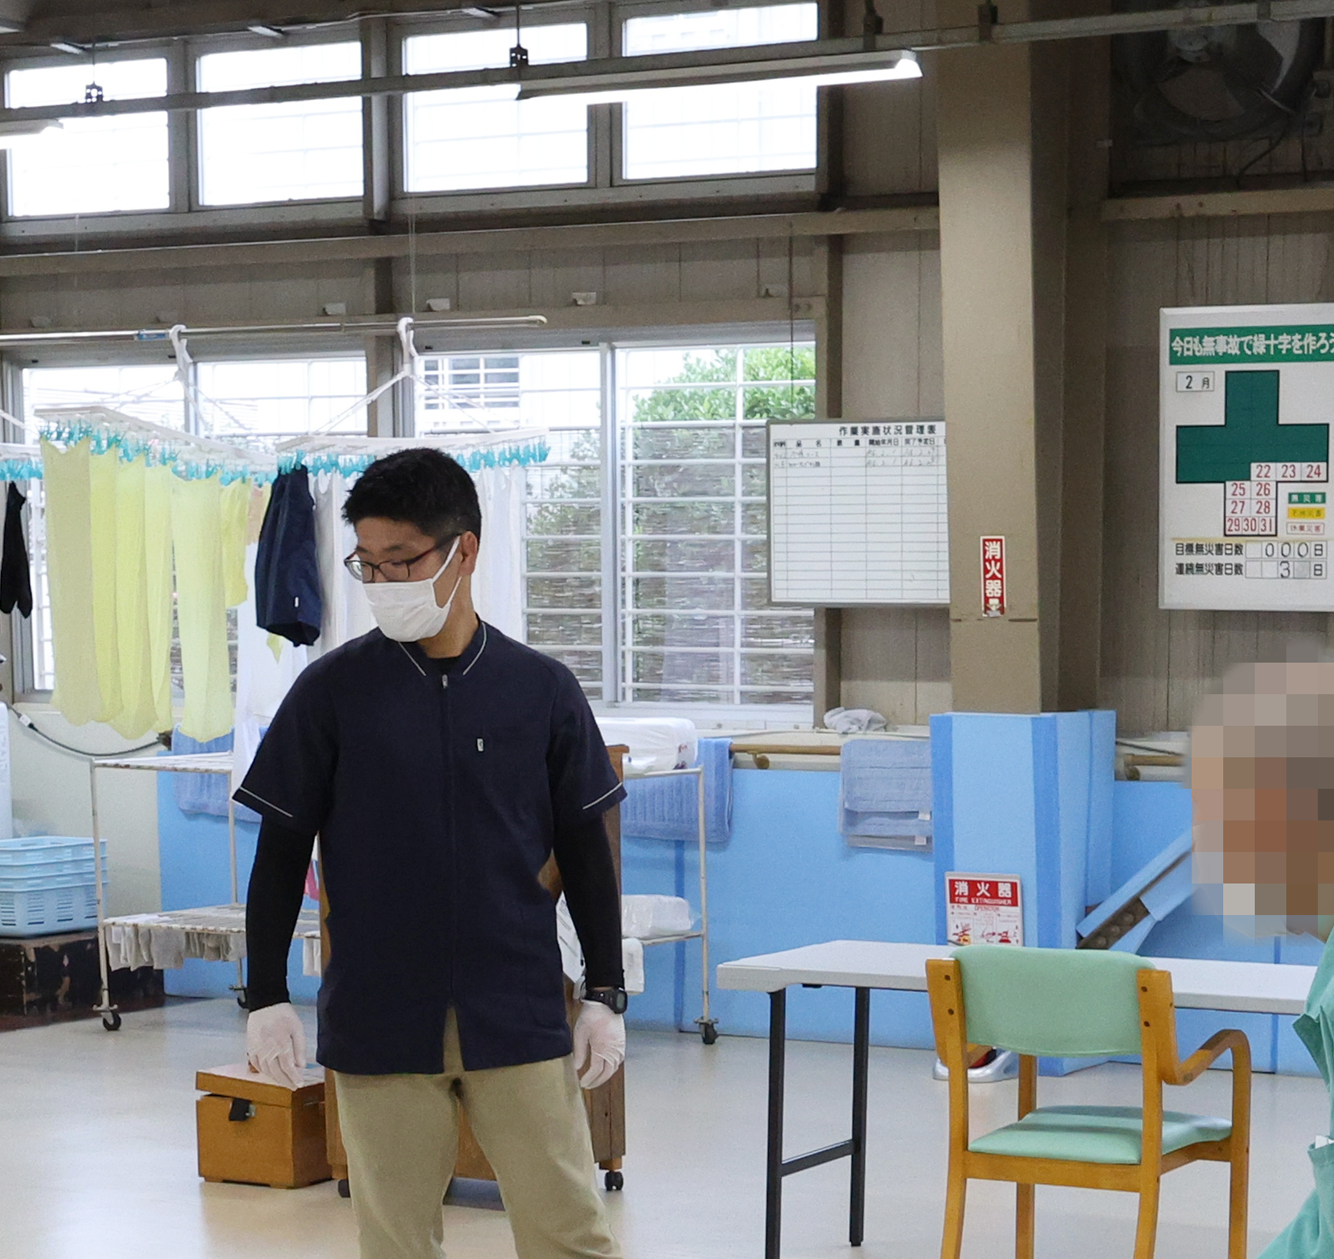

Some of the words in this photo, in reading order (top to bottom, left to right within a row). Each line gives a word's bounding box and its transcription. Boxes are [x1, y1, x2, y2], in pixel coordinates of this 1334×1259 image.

[1256, 464, 1271, 479] 22
[1281, 464, 1296, 479] 23
[1306, 464, 1322, 479] 24
[1231, 482, 1246, 497] 25
[1256, 482, 1271, 497] 26
[1231, 500, 1245, 514] 27
[1256, 500, 1271, 514] 28
[1227, 517, 1241, 532] 29
[1243, 517, 1257, 532] 30
[1260, 517, 1273, 532] 31
[984, 541, 1002, 597] 消火器
[954, 881, 1012, 898] 消火器
